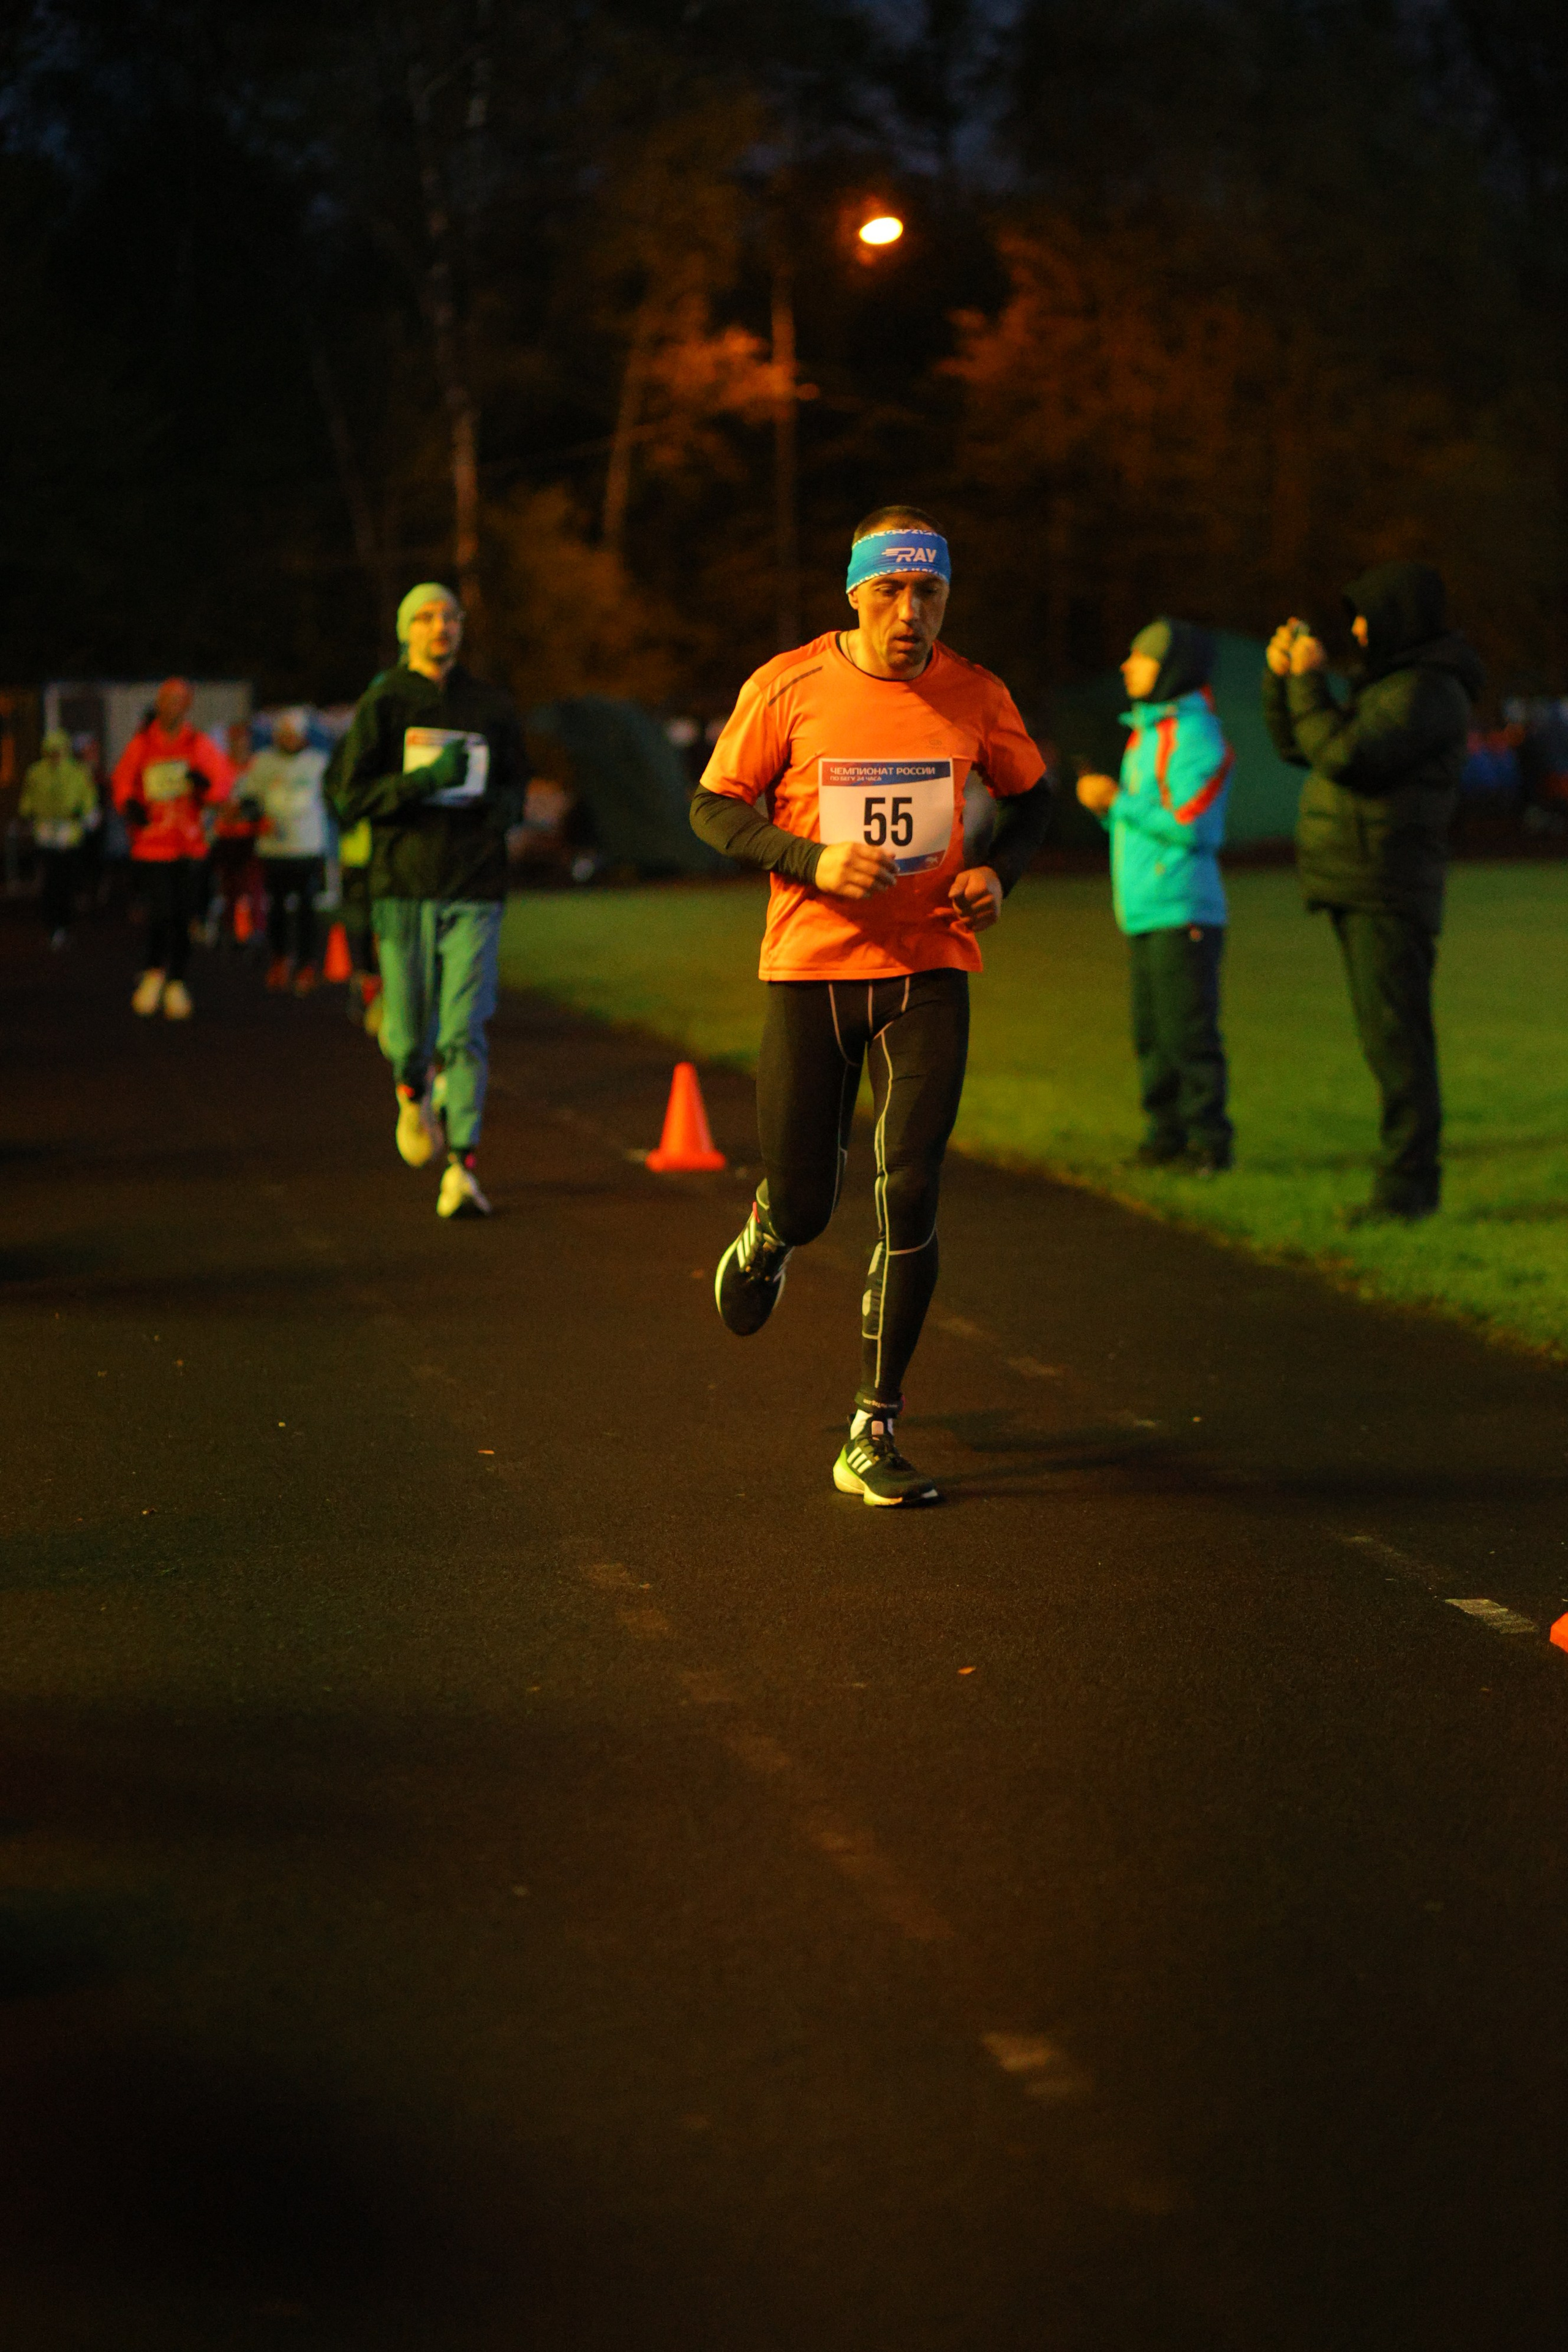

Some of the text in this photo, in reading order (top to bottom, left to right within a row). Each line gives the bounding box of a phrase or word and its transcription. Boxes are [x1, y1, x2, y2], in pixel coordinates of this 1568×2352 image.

[881, 547, 937, 562] RAY
[829, 767, 935, 775] ЧЕМПИОНАТ РОССИИ
[864, 797, 913, 846] 55
